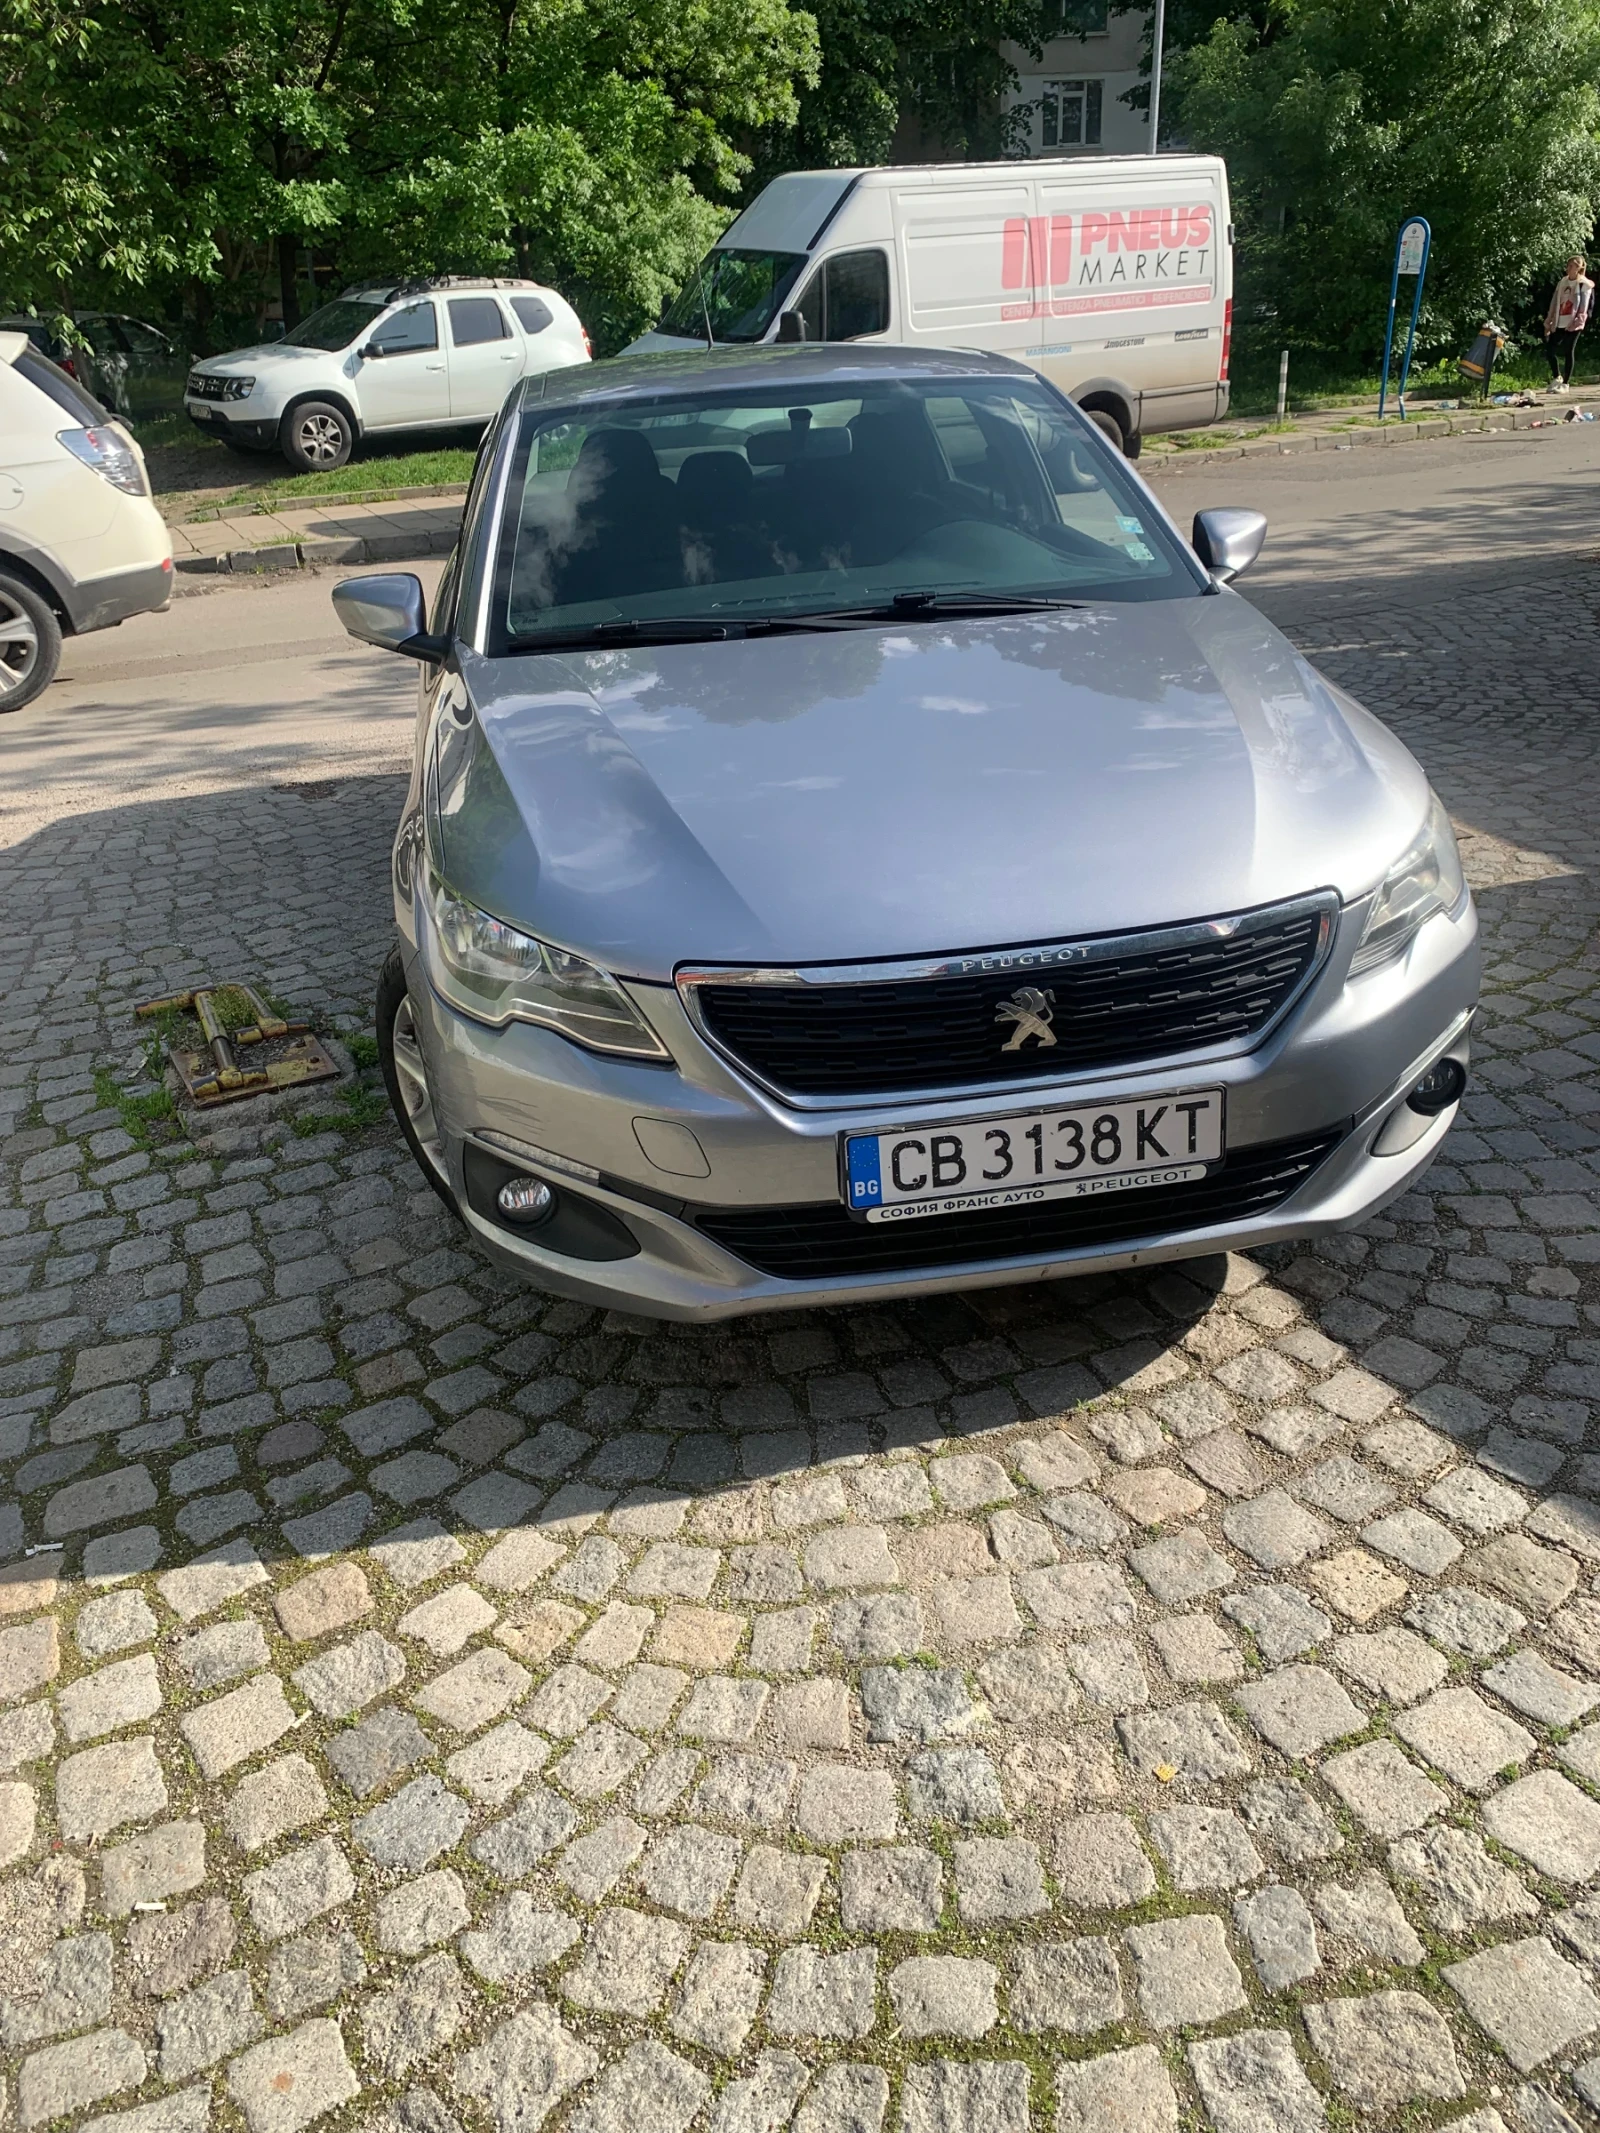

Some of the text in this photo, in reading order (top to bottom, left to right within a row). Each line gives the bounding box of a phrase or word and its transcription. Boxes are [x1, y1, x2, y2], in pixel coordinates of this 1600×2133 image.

[1080, 205, 1211, 255] PNEUS
[1079, 249, 1209, 285] MARKET
[1093, 294, 1146, 309] PNEUMATICI
[1025, 345, 1072, 357] MARANGONI
[961, 945, 1091, 972] PEUGEOT
[891, 1100, 1210, 1192] CB 3138 KT
[854, 1179, 879, 1197] BG
[1091, 1169, 1193, 1192] PEUGEOT
[880, 1188, 1046, 1220] СОФИЯ ФРАНС АУТО
